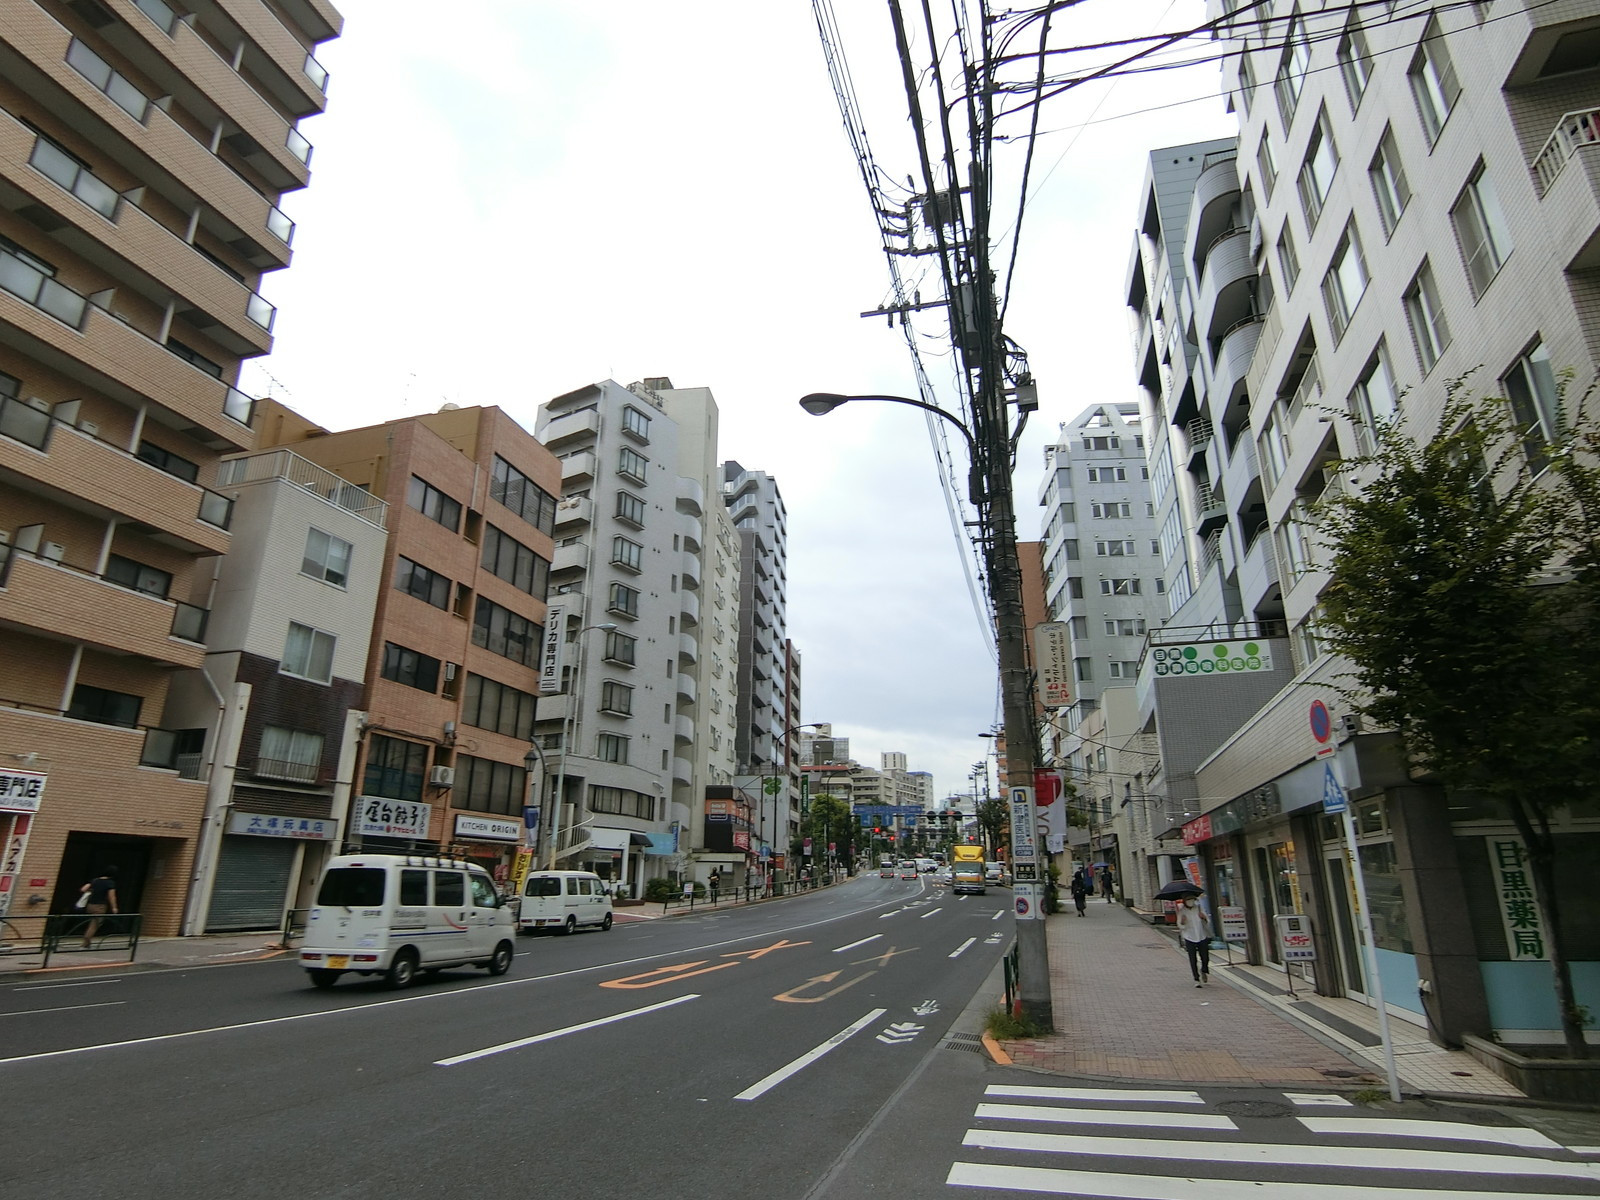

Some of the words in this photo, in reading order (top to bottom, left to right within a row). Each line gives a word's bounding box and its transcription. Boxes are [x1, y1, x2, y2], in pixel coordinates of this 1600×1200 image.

[544, 609, 560, 676] デリカ専門店
[365, 801, 419, 826] 屋台餃子
[461, 822, 488, 831] KITCHEN
[491, 824, 517, 835] ORIGIN
[1493, 840, 1545, 959] 目黒薬局
